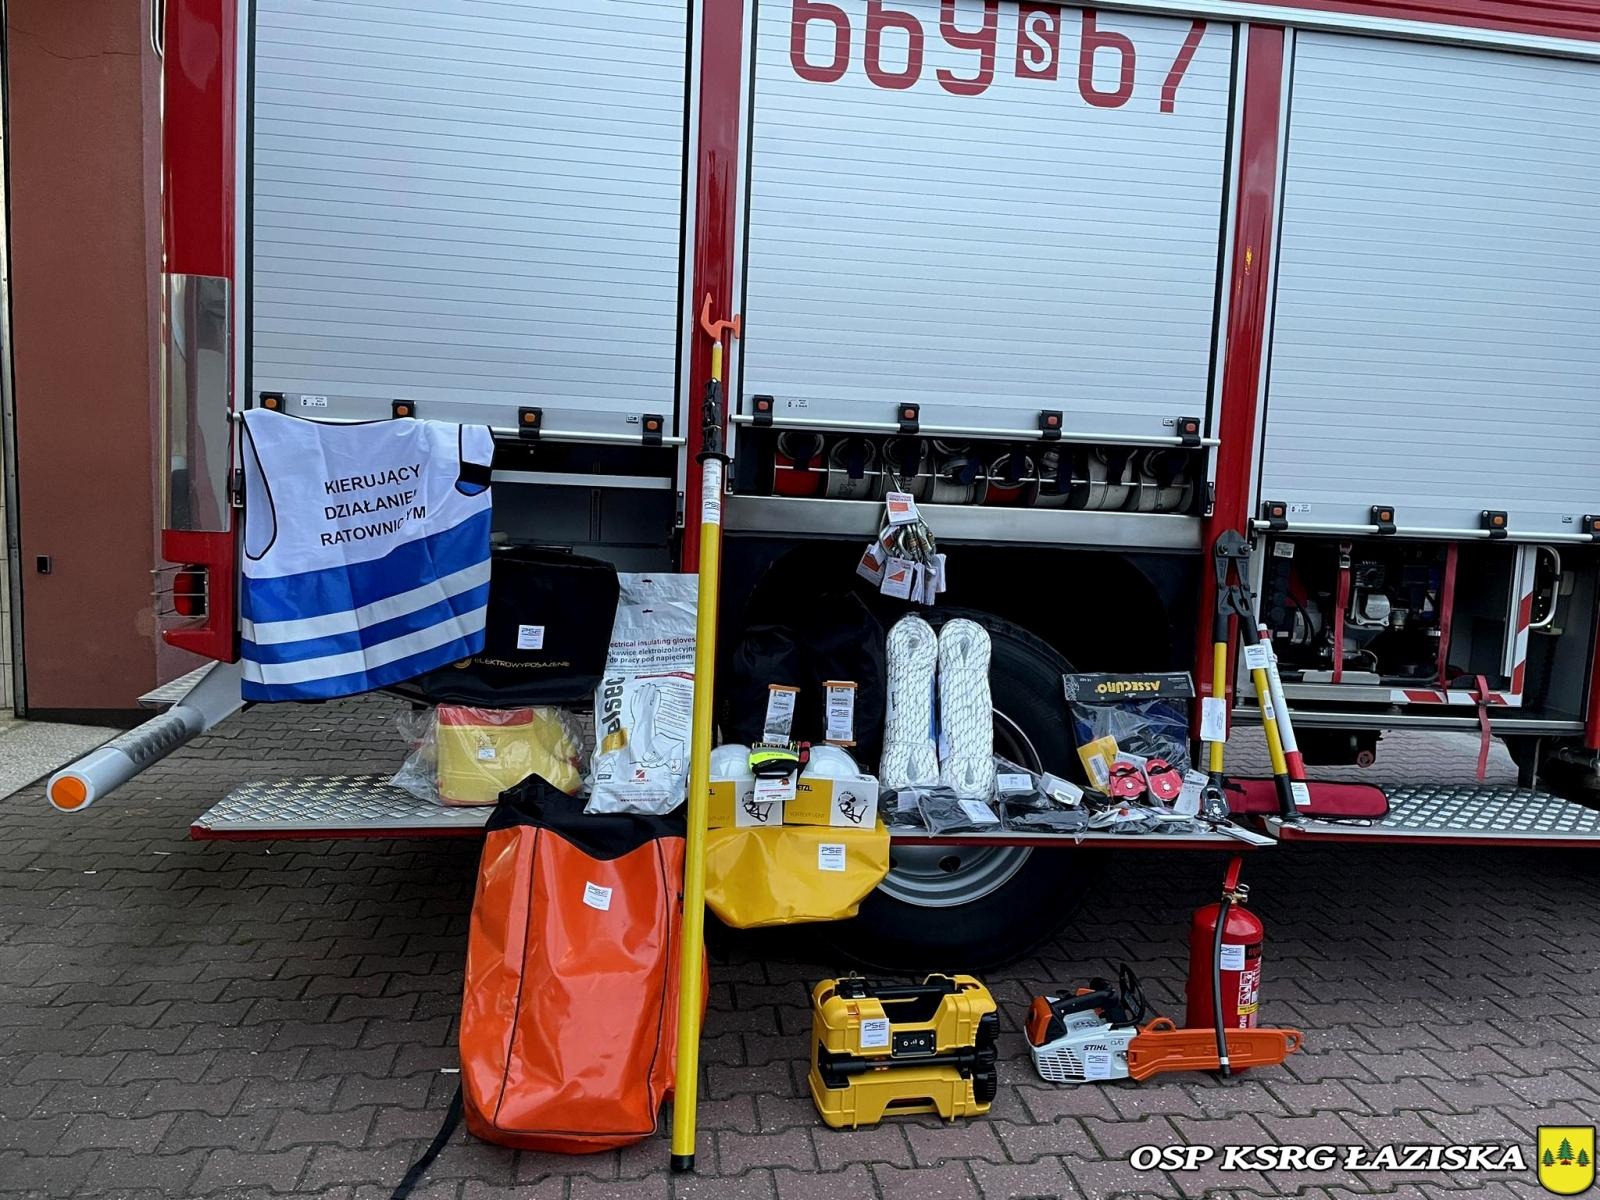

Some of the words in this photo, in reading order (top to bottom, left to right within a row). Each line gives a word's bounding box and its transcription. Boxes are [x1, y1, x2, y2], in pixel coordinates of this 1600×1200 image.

[324, 464, 421, 495] KIERUJĄCY
[324, 489, 417, 520] DZIAŁANIE
[609, 640, 636, 648] ectrical
[864, 1021, 886, 1030] PSE
